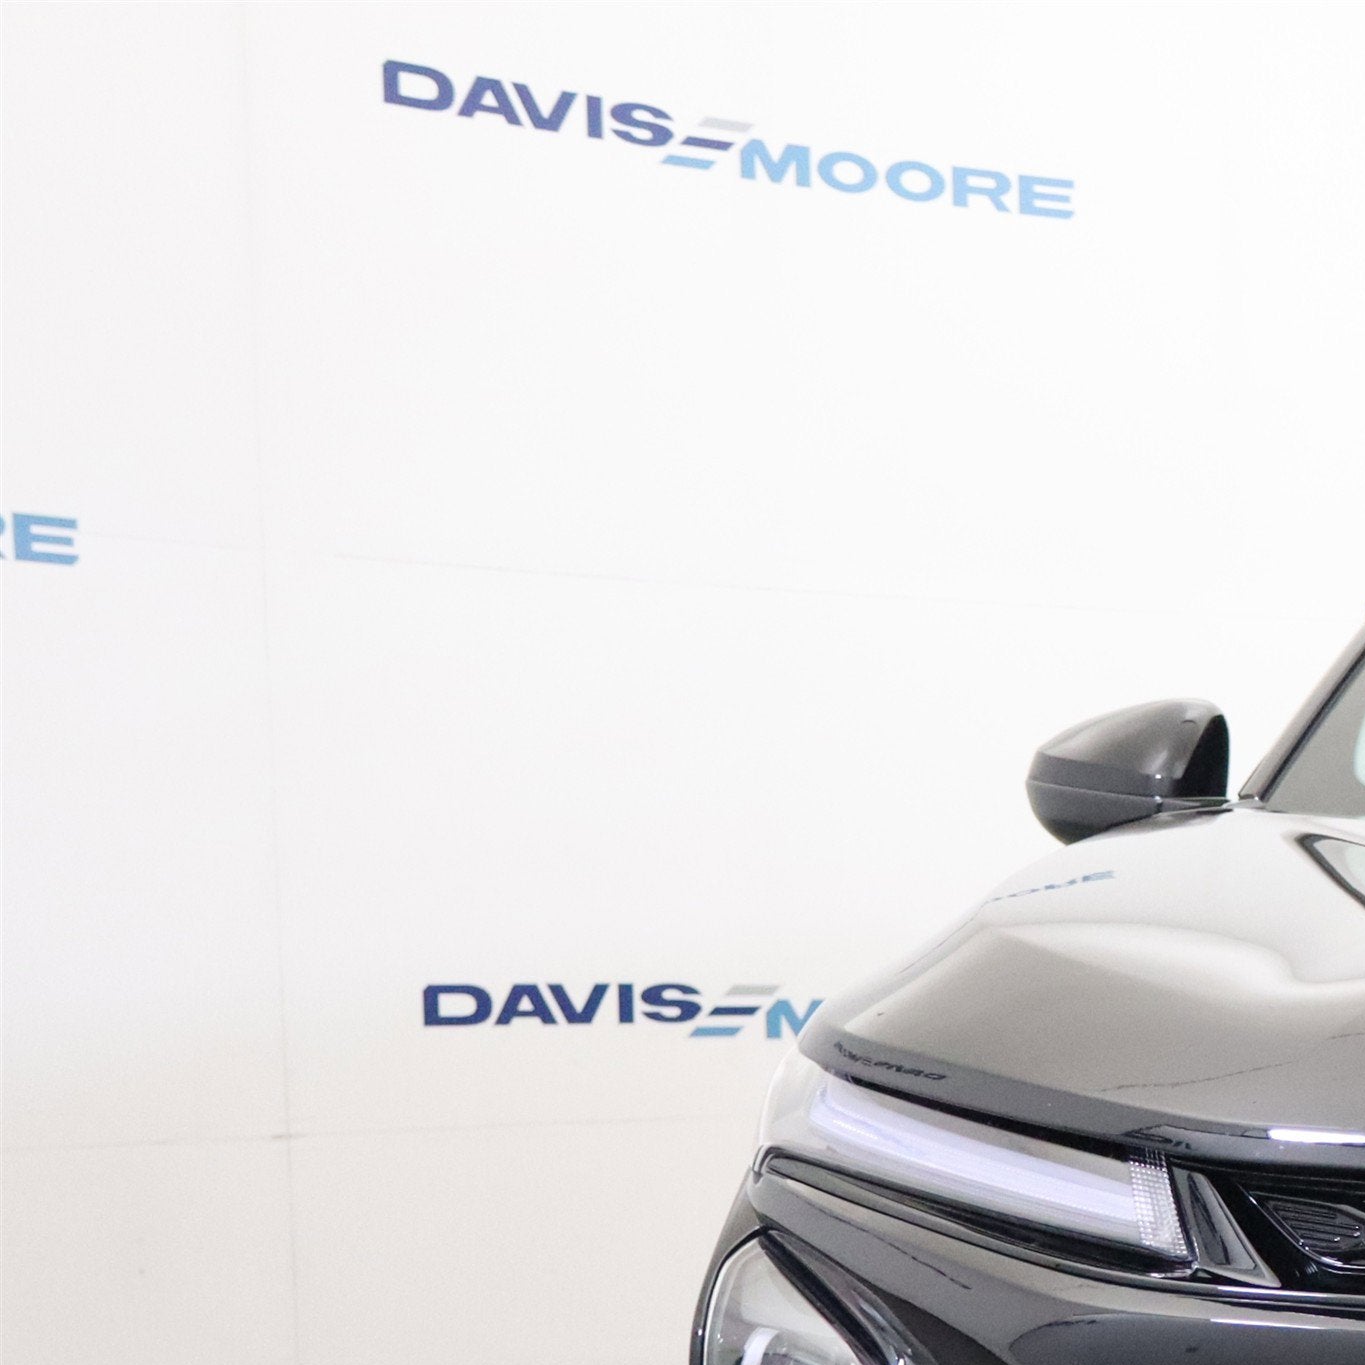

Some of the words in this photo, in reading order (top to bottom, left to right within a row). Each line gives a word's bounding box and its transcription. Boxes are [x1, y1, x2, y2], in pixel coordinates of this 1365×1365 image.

[382, 60, 675, 148] DAVIS
[739, 138, 1076, 220] MOORE
[423, 983, 703, 1027] DAVIS
